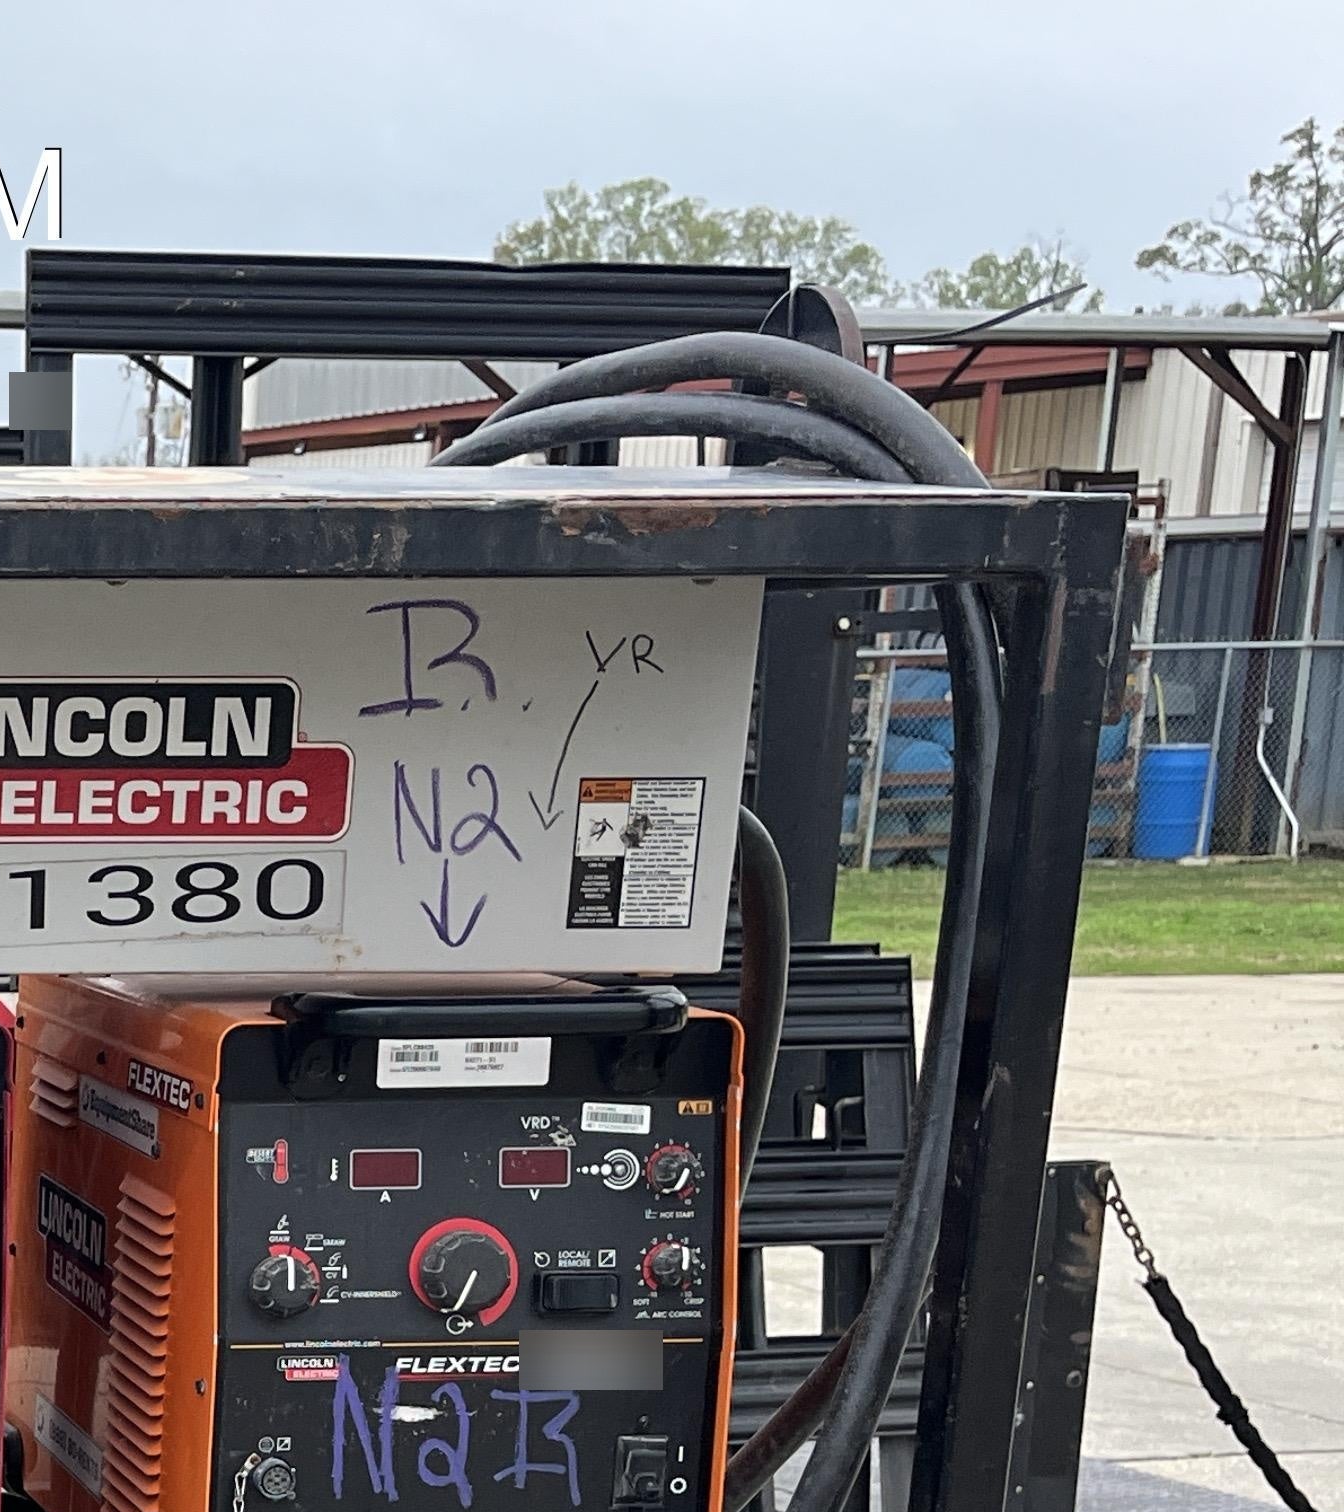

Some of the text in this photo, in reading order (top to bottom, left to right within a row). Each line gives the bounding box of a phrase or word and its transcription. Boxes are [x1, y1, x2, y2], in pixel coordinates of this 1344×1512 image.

[0, 780, 308, 825] ELECTRIC
[128, 1062, 191, 1110] FLEXTEC
[380, 1191, 391, 1203] A
[530, 1189, 540, 1201] V
[41, 1187, 102, 1266] LINCOLN
[559, 1251, 589, 1259] LOCAL/
[558, 1259, 590, 1267] REMOTE
[52, 1250, 106, 1319] ELECTRIC
[281, 1359, 333, 1368] LINCOLN
[396, 1356, 520, 1373] FLEXTEC
